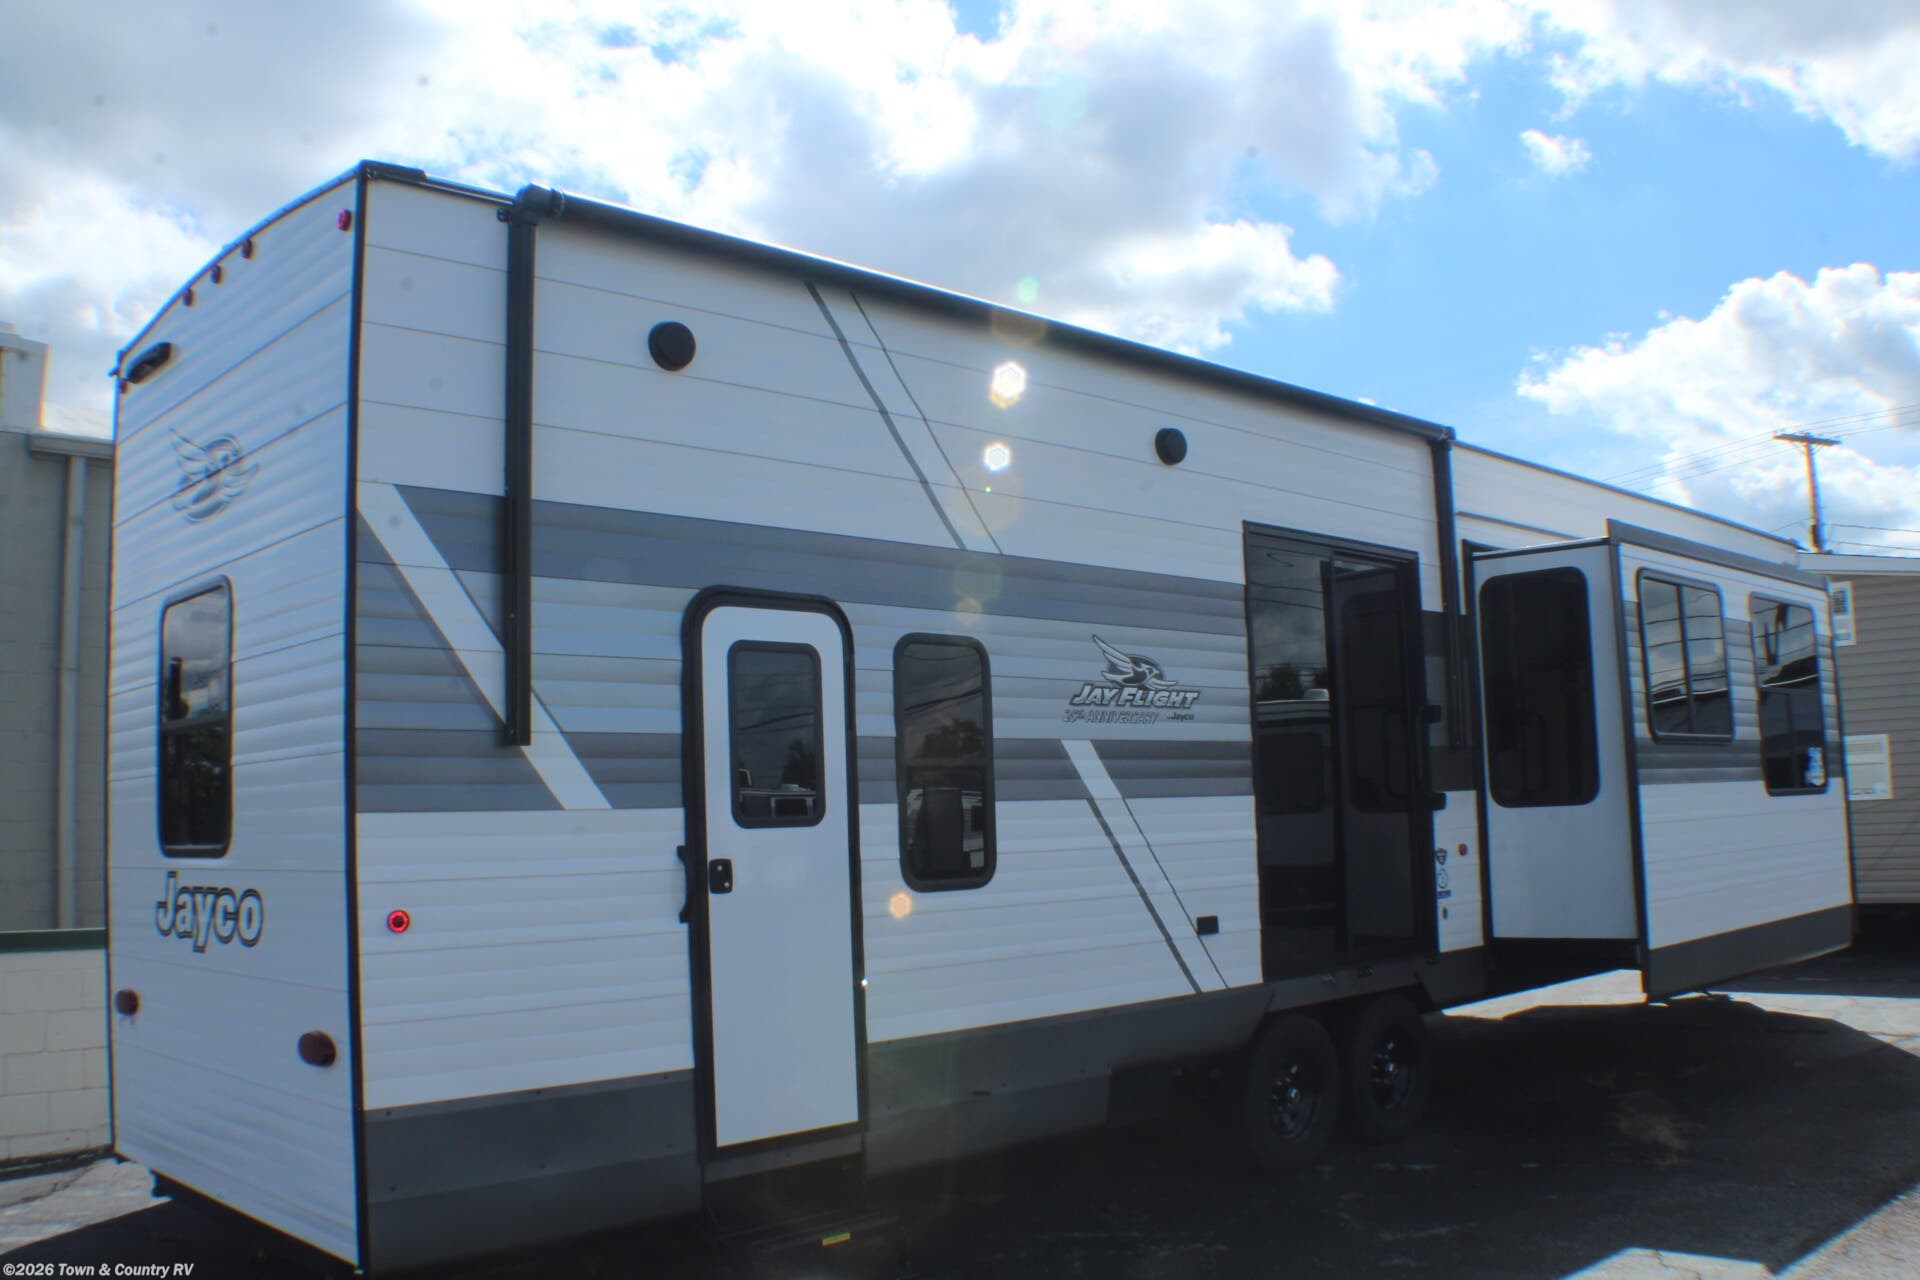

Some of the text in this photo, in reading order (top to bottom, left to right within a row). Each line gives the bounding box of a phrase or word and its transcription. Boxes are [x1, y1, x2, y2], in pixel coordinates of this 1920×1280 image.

[1070, 684, 1200, 709] JAY FLIGHT
[156, 870, 264, 953] Jayco
